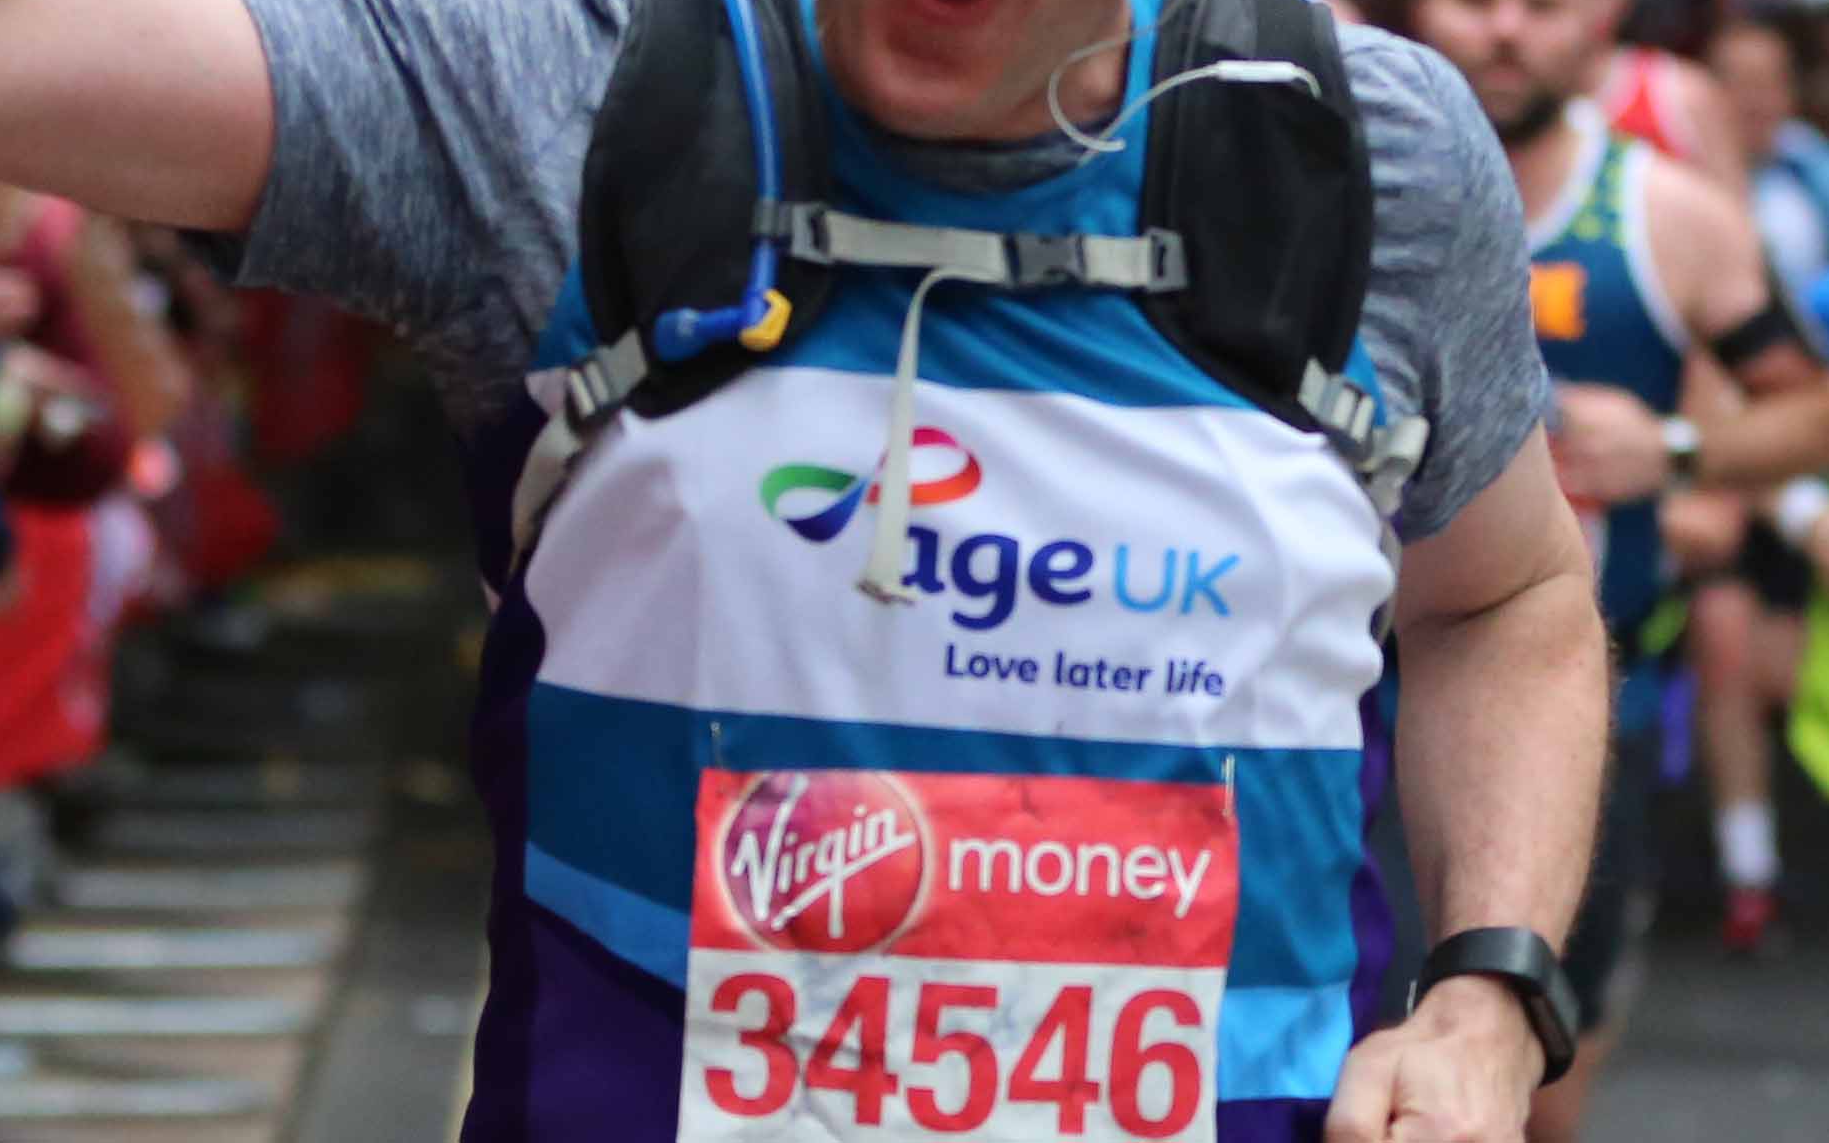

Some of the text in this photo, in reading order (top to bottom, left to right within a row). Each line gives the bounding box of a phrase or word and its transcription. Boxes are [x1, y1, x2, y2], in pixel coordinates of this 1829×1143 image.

[1113, 543, 1241, 617] UK
[945, 643, 1226, 697] Love later life
[731, 774, 1212, 939] Virgin money
[703, 972, 1203, 1140] 34546
